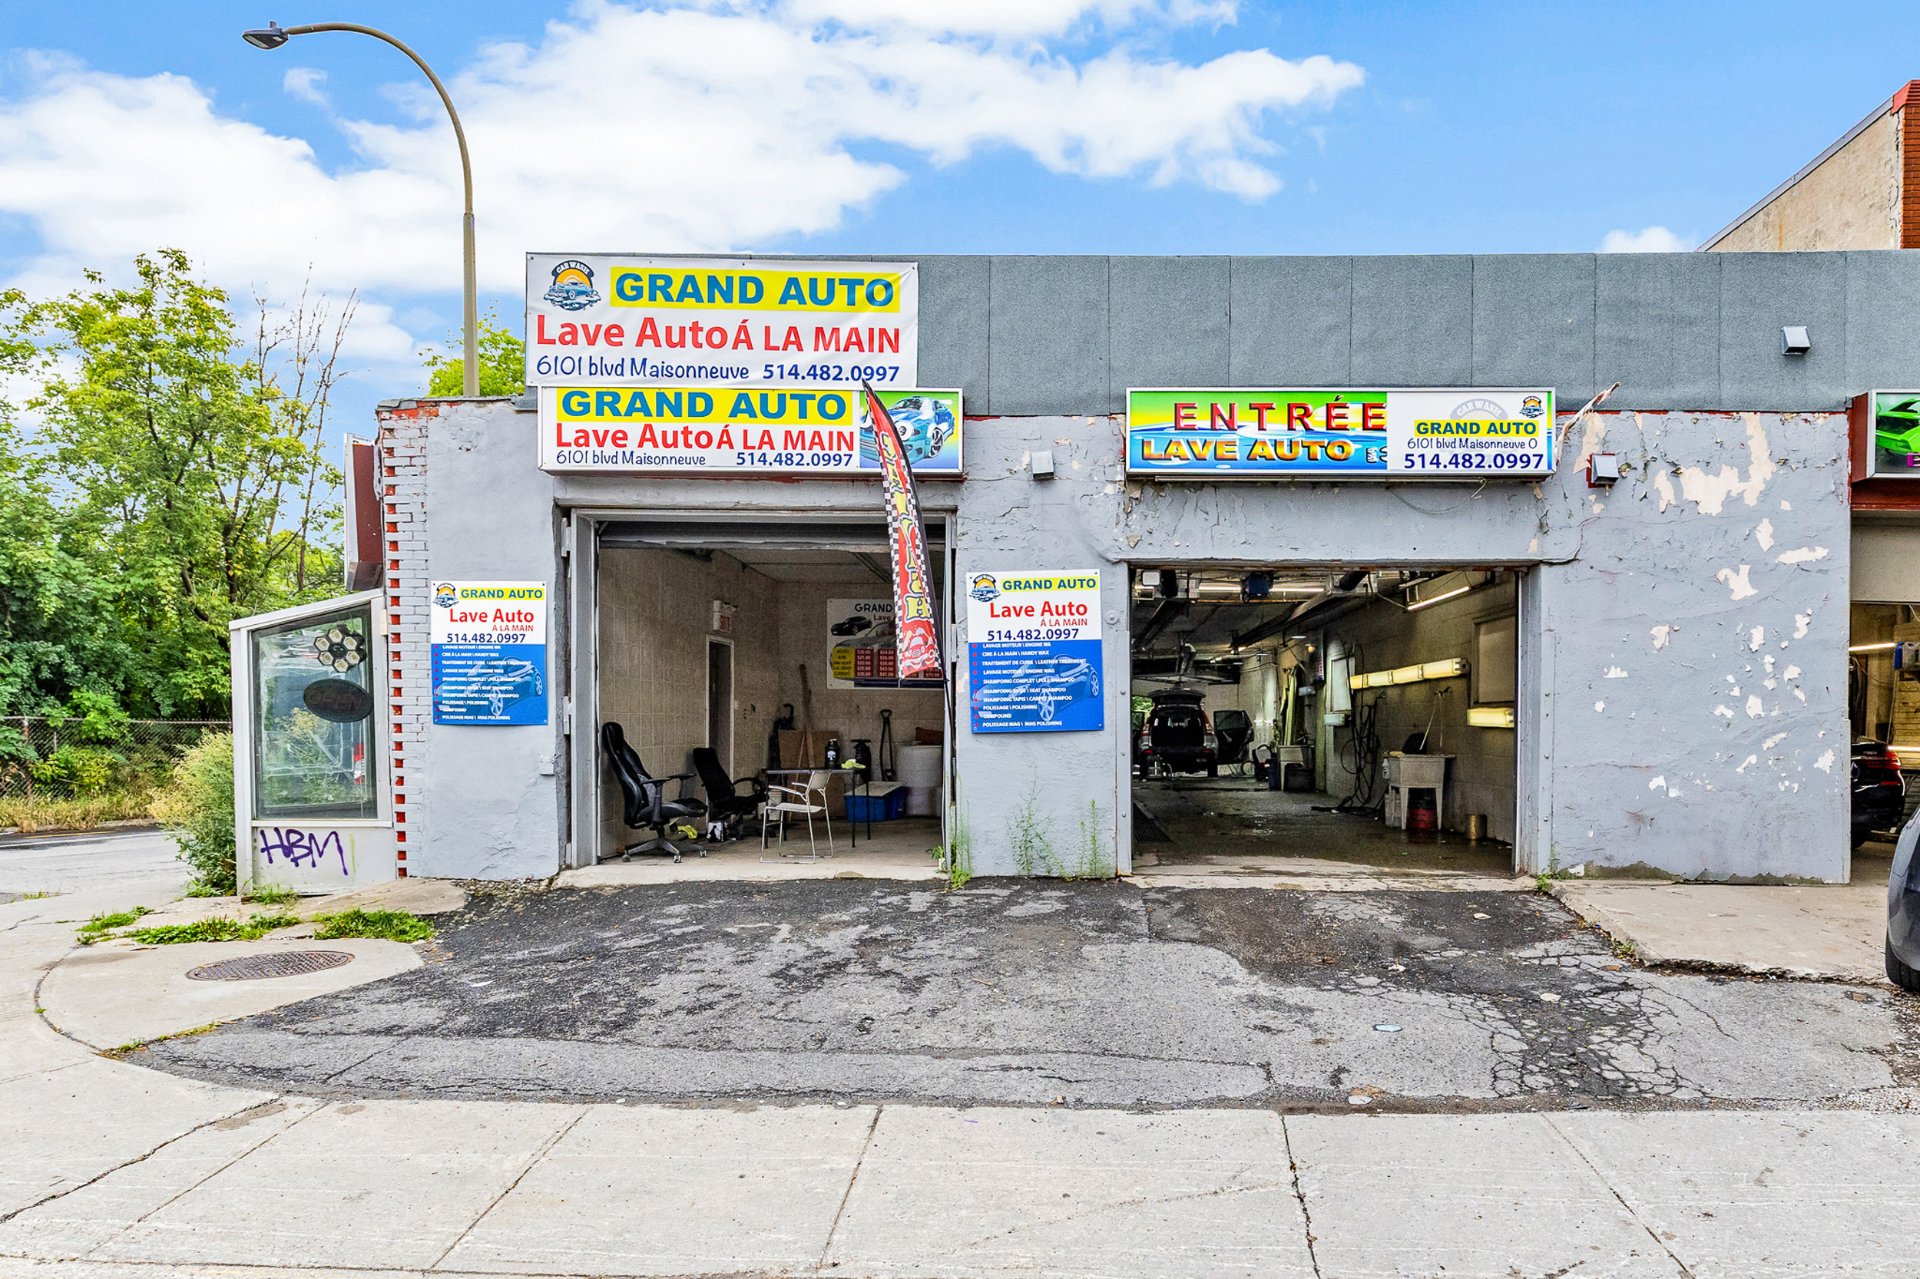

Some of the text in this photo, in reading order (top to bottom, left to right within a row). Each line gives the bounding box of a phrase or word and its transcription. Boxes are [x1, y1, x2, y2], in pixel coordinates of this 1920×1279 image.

[615, 272, 894, 308] GRAND AUTO
[537, 315, 625, 348] Lave
[636, 317, 727, 350] Auto
[764, 325, 803, 352] LA
[814, 327, 900, 353] MAIN
[536, 356, 899, 382] 6101 blvd Maisonneuve 514.482.0997
[562, 390, 846, 420] GRAND AUTO
[1174, 394, 1386, 431] ENTRÉE
[1416, 422, 1536, 434] GRAND AUTO
[556, 424, 628, 448] Lave
[637, 424, 714, 450] Auto
[743, 429, 776, 450] LA
[784, 430, 854, 452] MAIN
[1407, 438, 1432, 449] 6101
[1436, 438, 1456, 449] blvd
[1459, 438, 1525, 449] Maisonneuve
[1141, 439, 1239, 461] LAVE
[1246, 439, 1356, 461] AUTO
[556, 450, 853, 467] 6101 blvd Maisonneuve 514.482.0997
[1404, 453, 1543, 469] 514.482.0997
[1002, 578, 1096, 590] GRAND AUTO
[461, 589, 542, 598] GRAND AUTO
[450, 608, 534, 623] Lave Auto
[855, 603, 892, 612] GRAND
[990, 601, 1088, 618] Lave Auto
[1062, 618, 1088, 626] MAIN
[447, 634, 526, 643] 514.482.0997
[987, 628, 1079, 641] 514.482.0997
